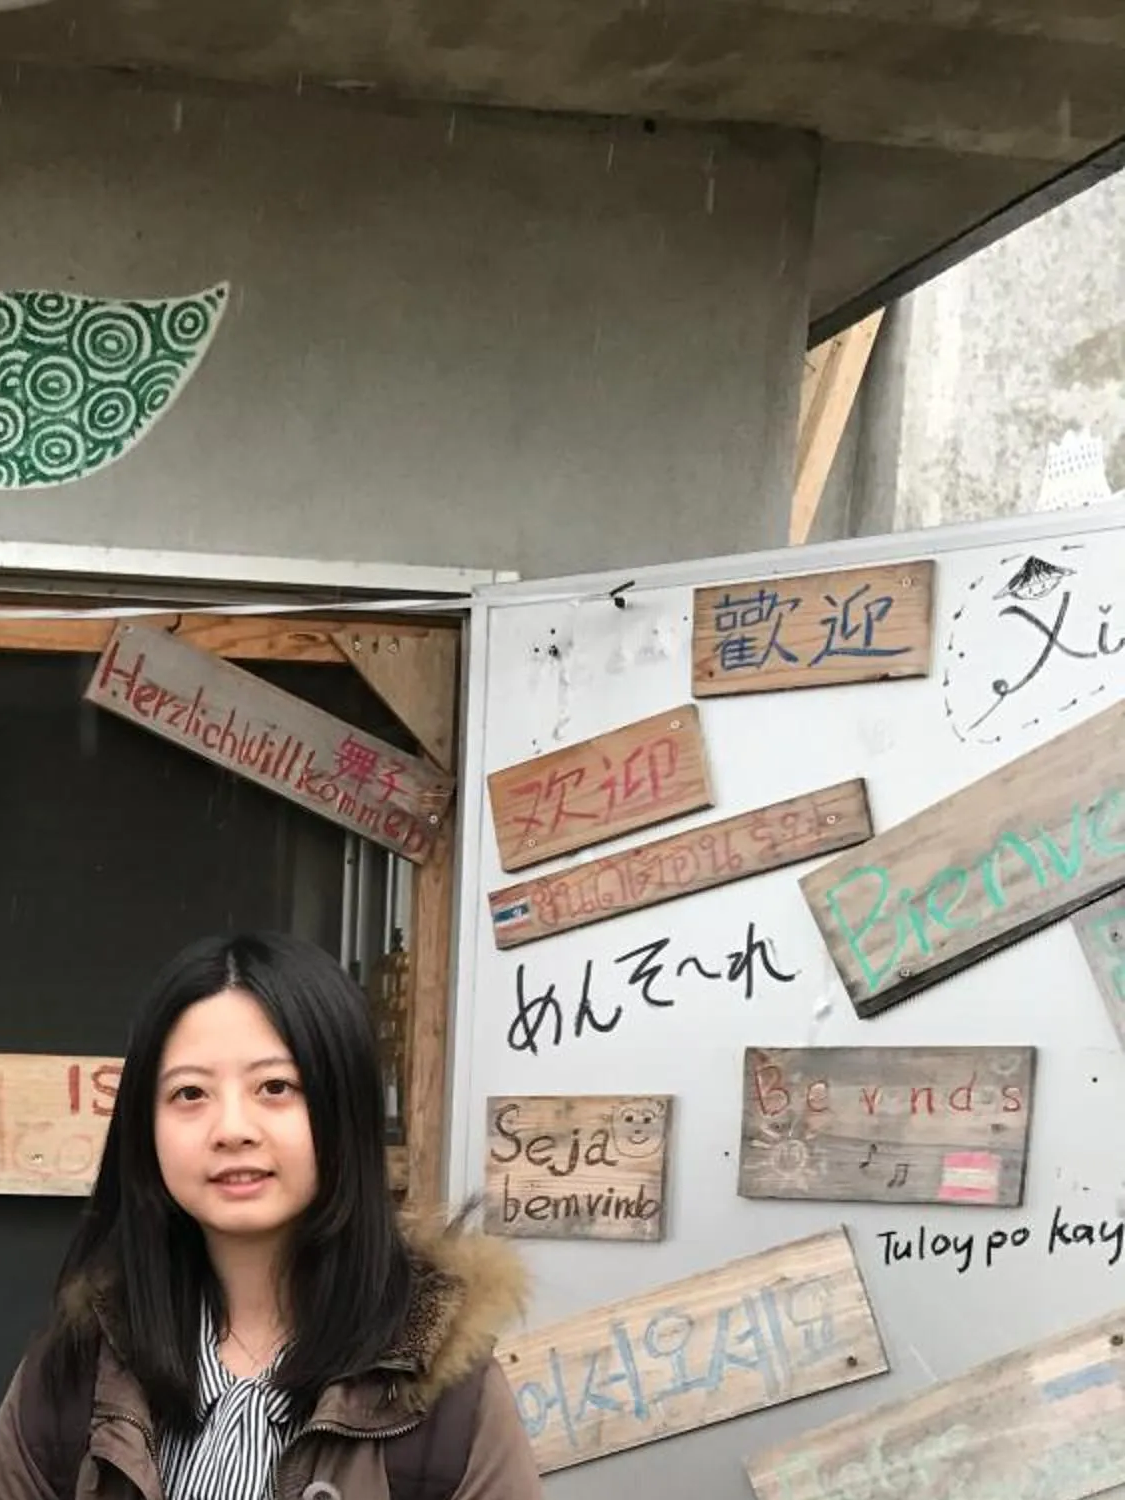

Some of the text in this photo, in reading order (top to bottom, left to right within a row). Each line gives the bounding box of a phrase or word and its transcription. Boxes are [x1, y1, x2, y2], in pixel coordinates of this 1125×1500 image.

[713, 584, 914, 672] 歡迎
[505, 736, 679, 846] 欢迎
[490, 1103, 619, 1177] Seja
[877, 1224, 974, 1273] Tuloy
[985, 1227, 1031, 1268] po
